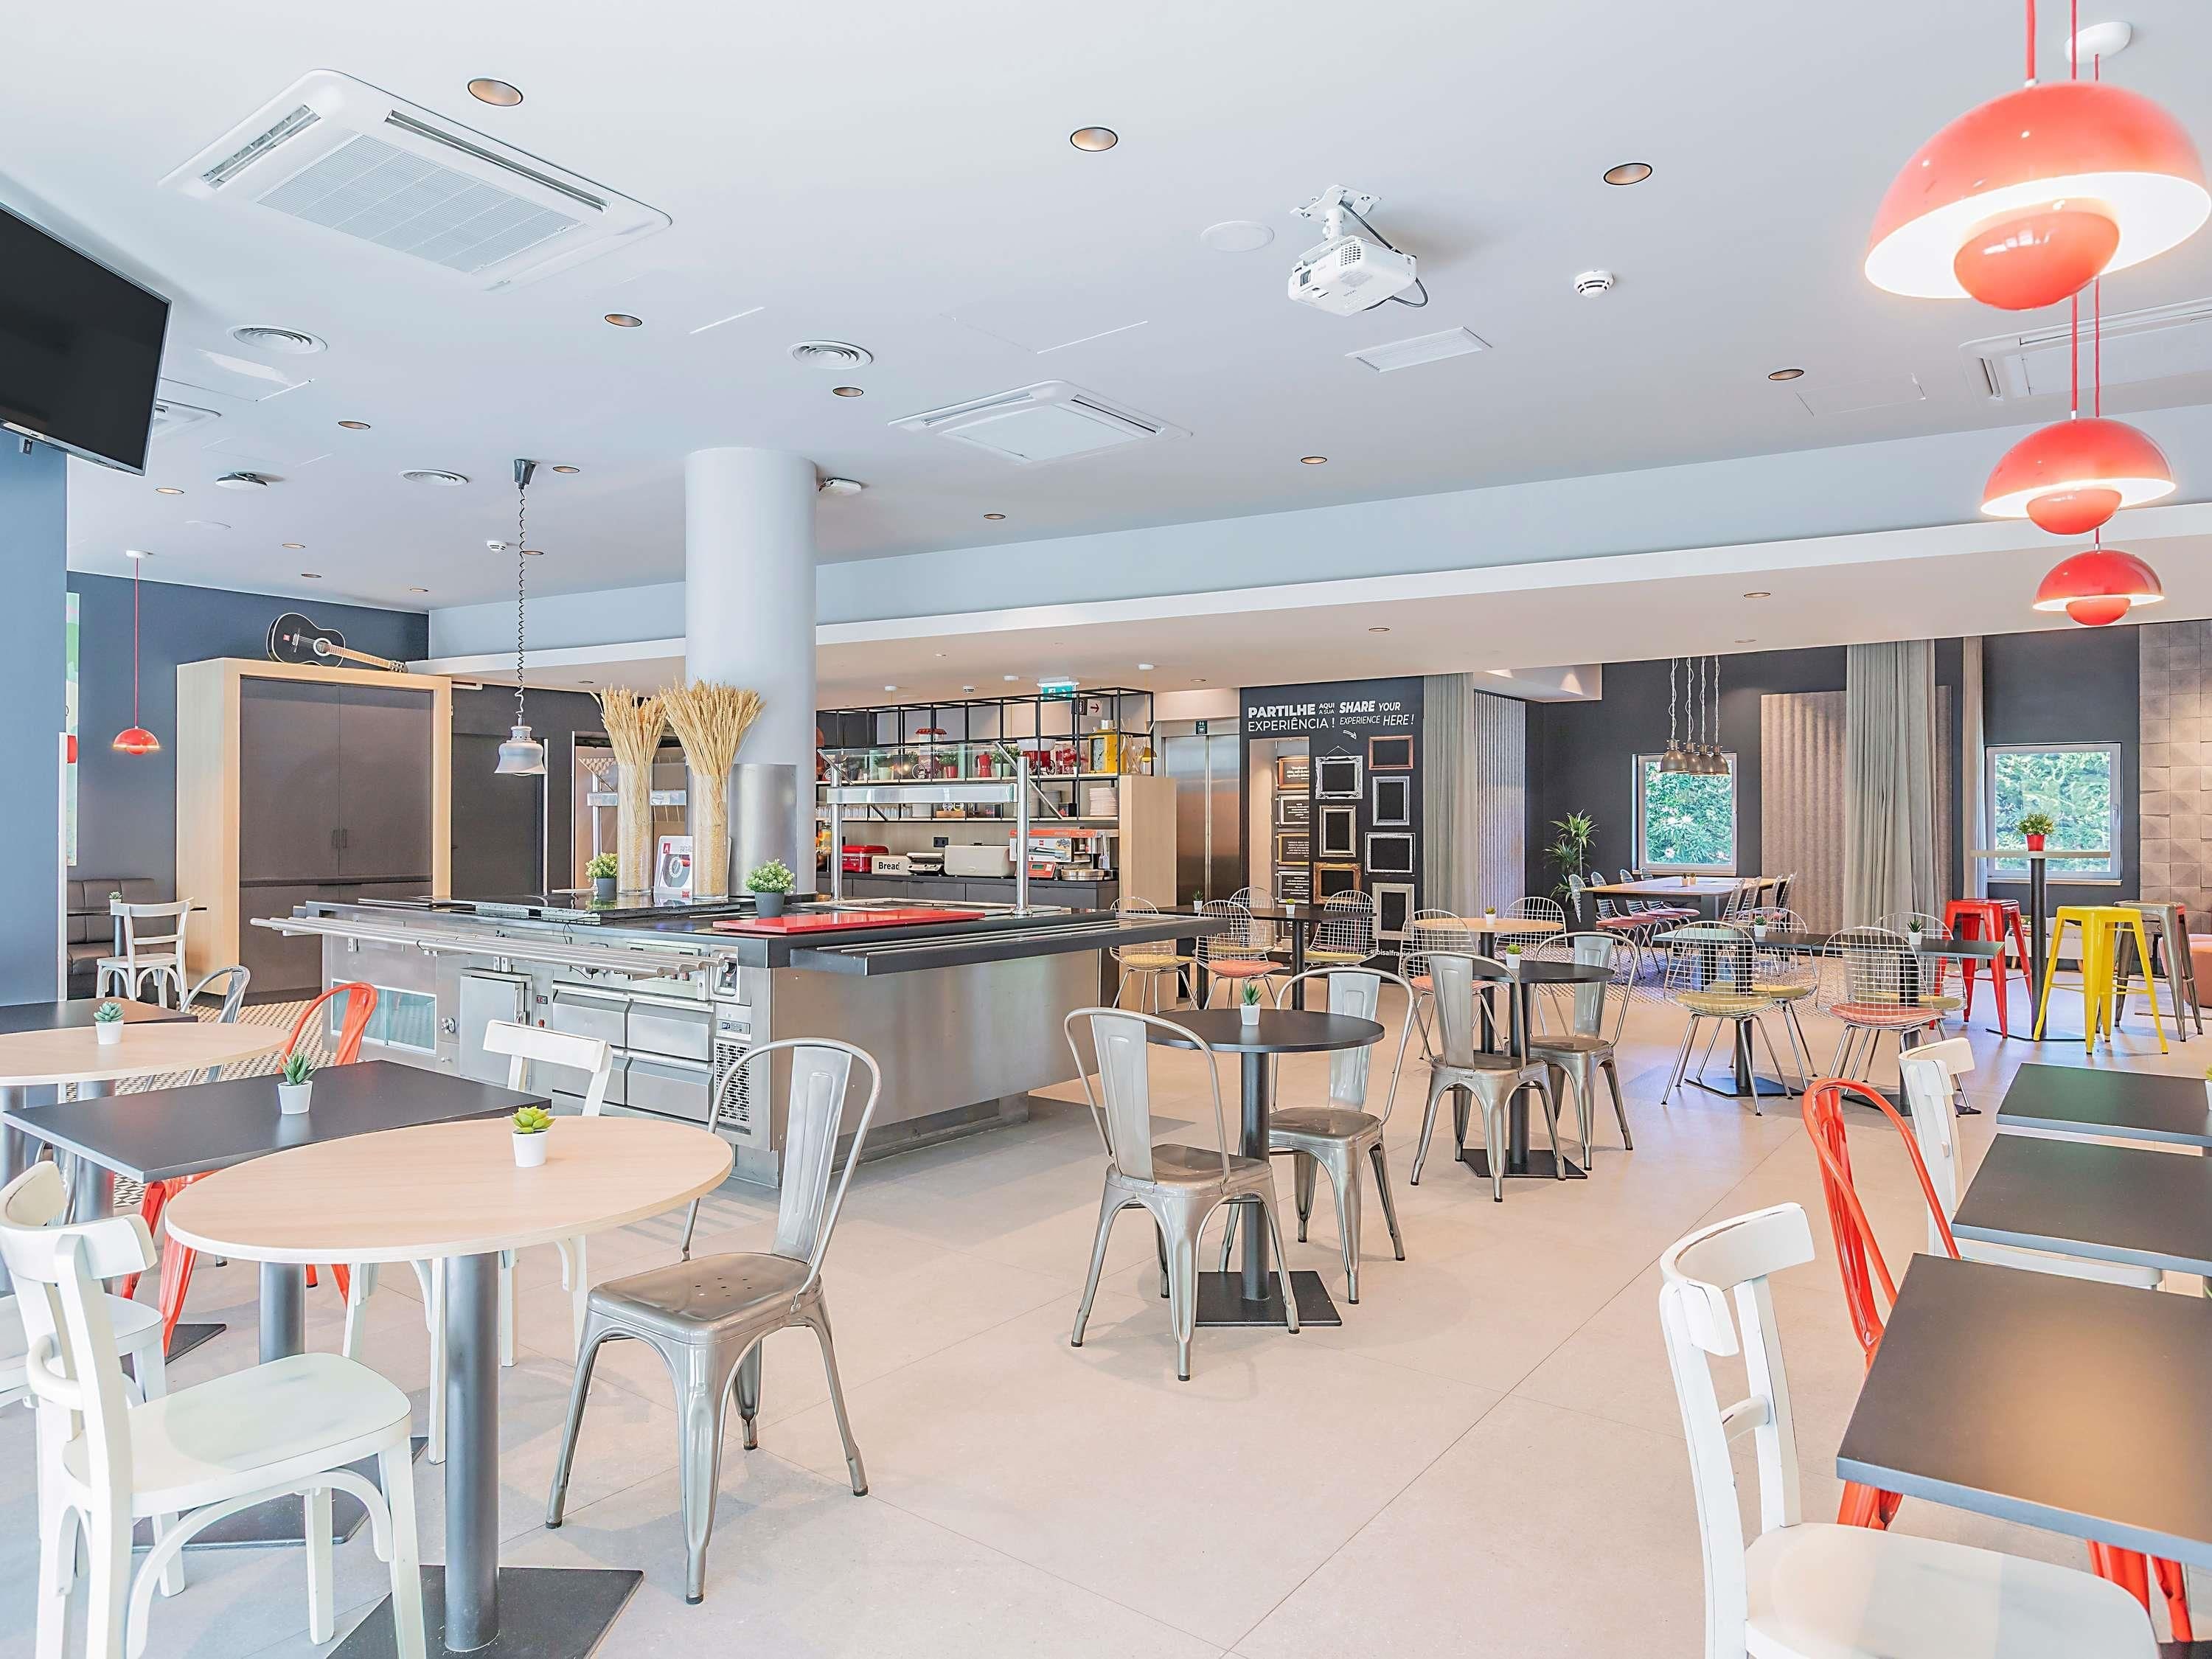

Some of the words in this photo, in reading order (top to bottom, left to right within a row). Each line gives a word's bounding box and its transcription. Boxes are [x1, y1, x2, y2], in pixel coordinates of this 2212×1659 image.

[1248, 703, 1316, 718] PARTILHE
[1339, 700, 1376, 714] SHARE
[1378, 701, 1401, 712] YOUR
[1248, 717, 1329, 732] EXPERIÊNCIA
[1339, 715, 1381, 726] EXPERIENCE
[1382, 714, 1410, 726] HERE
